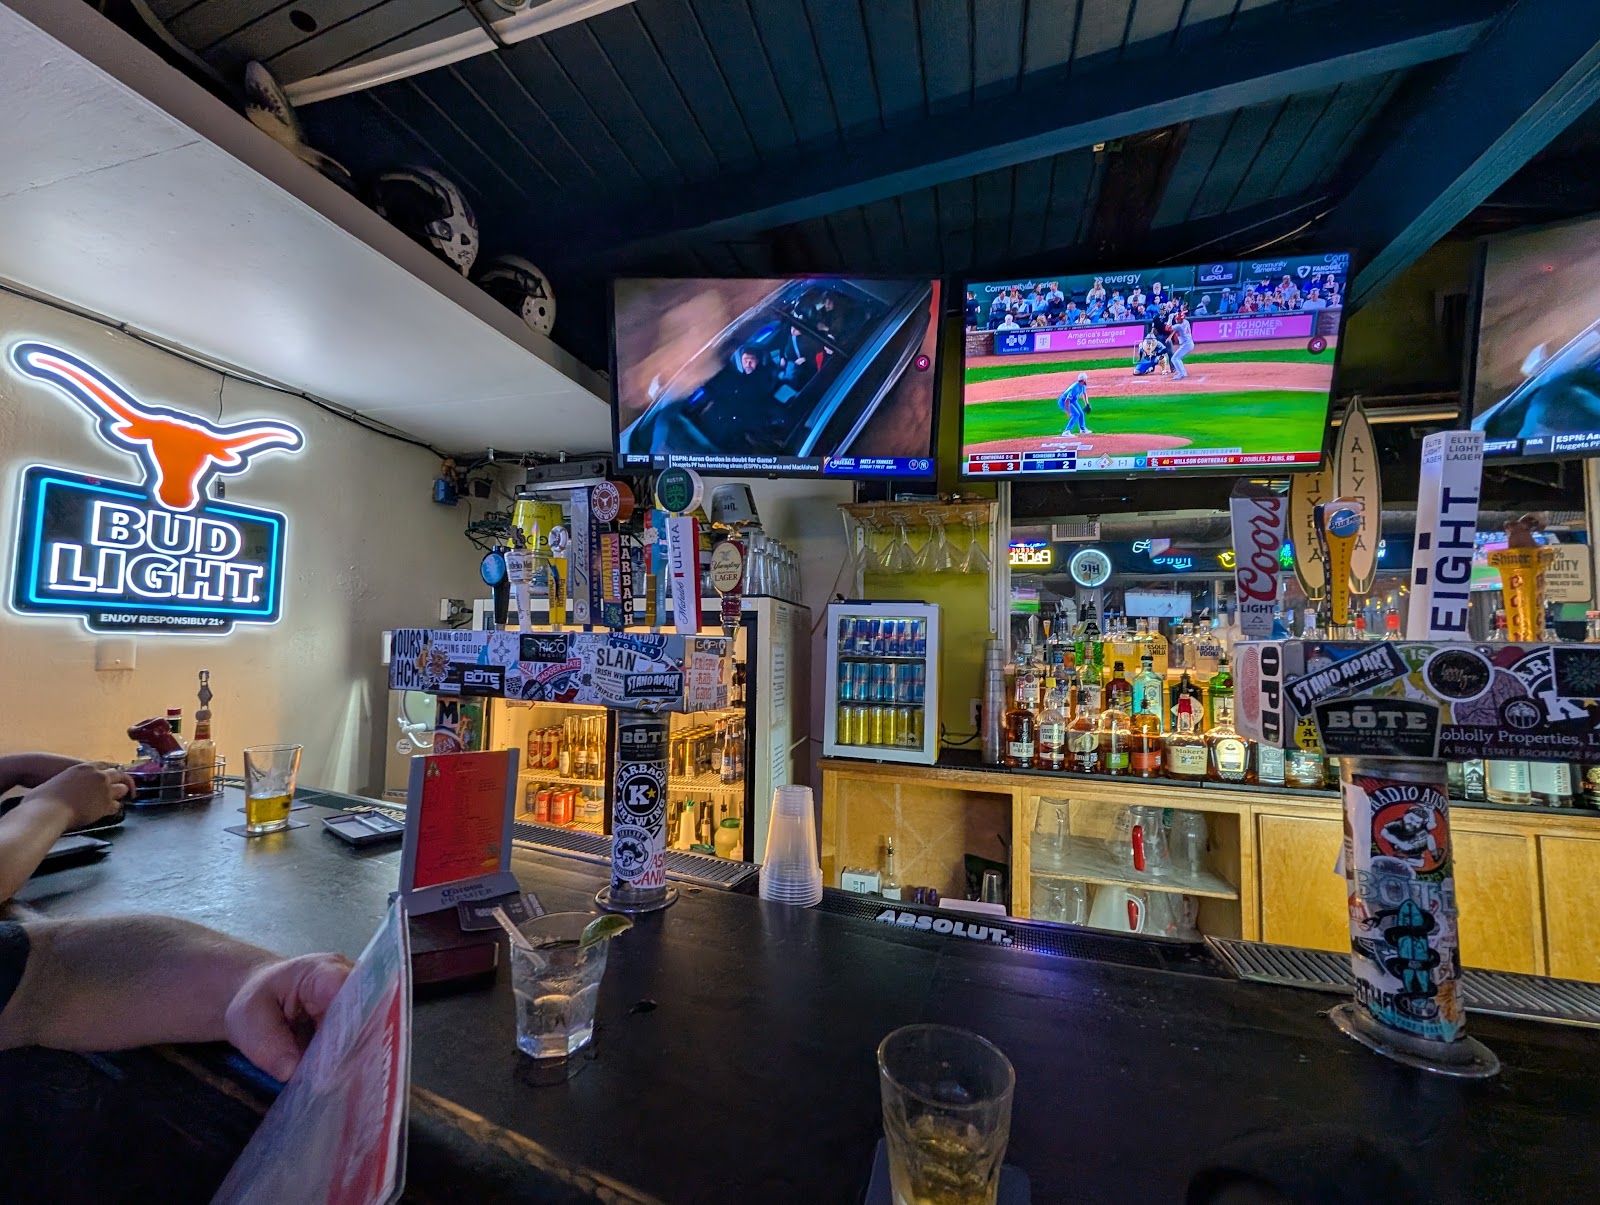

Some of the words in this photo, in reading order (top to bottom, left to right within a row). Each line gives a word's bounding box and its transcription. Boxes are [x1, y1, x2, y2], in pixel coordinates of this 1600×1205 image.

[1105, 273, 1141, 285] evergy
[1201, 273, 1233, 281] LEXUS
[1236, 321, 1248, 329] 5G
[1249, 320, 1276, 329] HOME
[1067, 331, 1100, 340] America's
[1101, 329, 1126, 338] largest
[1234, 328, 1276, 337] INTERNET
[1077, 338, 1087, 346] 5G
[1088, 337, 1116, 345] network
[1425, 438, 1442, 448] ELITE
[1450, 436, 1480, 444] ELITE
[1556, 433, 1585, 443] ESPN:
[1449, 445, 1480, 453] LIGHT
[1482, 440, 1518, 451] ESPN
[1556, 441, 1589, 450] Nuggets
[1423, 455, 1442, 464] LAGER
[1446, 453, 1482, 461] LAGER
[1006, 462, 1014, 471] 3
[1062, 460, 1069, 469] 2
[593, 481, 618, 500] KARBACH
[593, 505, 619, 520] BREWING
[91, 500, 241, 560] BUD
[671, 523, 683, 569] ULTRA
[1236, 497, 1281, 603] Coors
[1430, 487, 1479, 632] EIGHT
[601, 537, 613, 600] HOPADILLO
[712, 561, 741, 571] Yuengling
[620, 534, 634, 625] KARBACH
[714, 573, 738, 581] LAGER
[673, 580, 688, 625] Michelob
[1240, 604, 1275, 614] LIGHT
[100, 613, 138, 623] ENJOY
[139, 615, 208, 626] RESPONSIBLY
[208, 617, 225, 626] 21+
[434, 631, 452, 641] DAMN
[454, 632, 473, 642] GOOD
[461, 644, 483, 654] GUIDE
[615, 642, 655, 654] VODKA
[696, 639, 726, 650] GoPro
[597, 648, 637, 672] SLAN
[536, 663, 561, 683] BADGER
[594, 667, 613, 678] IRISH
[1293, 668, 1342, 708] STAND
[1339, 646, 1395, 679] APART
[627, 675, 654, 692] STAND
[653, 674, 680, 692] APART
[595, 683, 614, 699] TRIPLE
[1538, 690, 1590, 722] K
[1498, 730, 1583, 746] Properties,
[1482, 747, 1515, 756] ESTATE
[617, 763, 666, 790] KARBACH
[628, 785, 649, 806] K
[616, 799, 666, 827] BREWING
[441, 883, 484, 897] Corona
[440, 888, 492, 905] PREMIER
